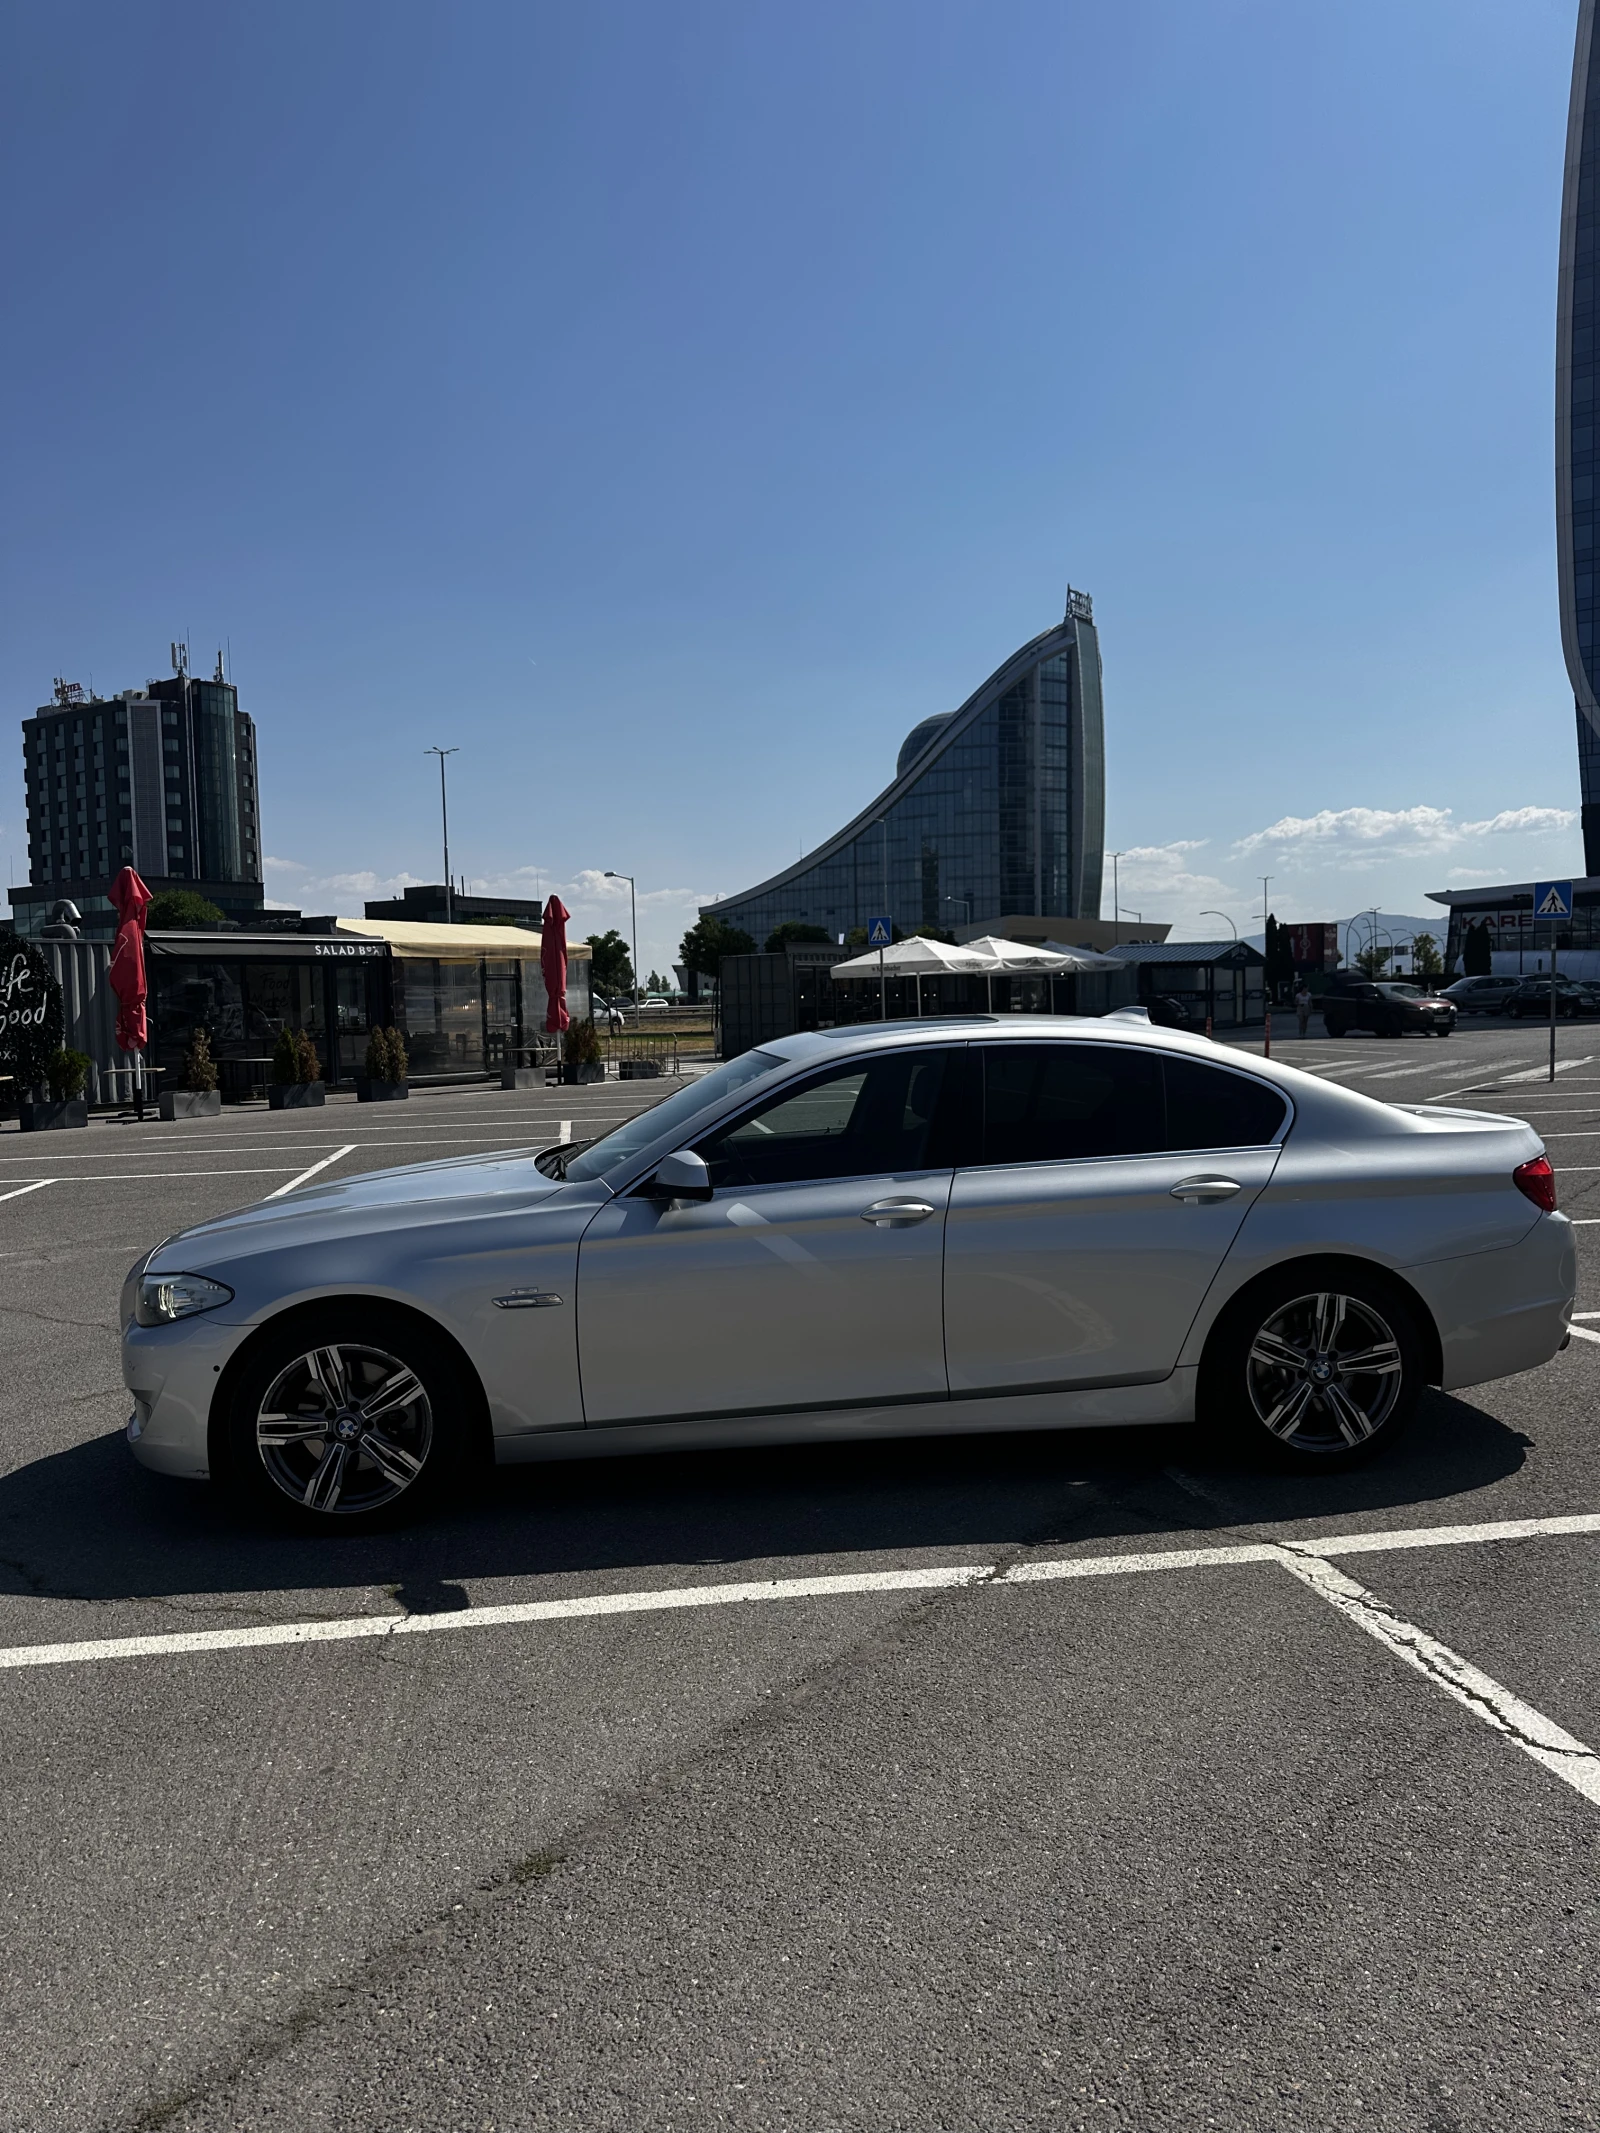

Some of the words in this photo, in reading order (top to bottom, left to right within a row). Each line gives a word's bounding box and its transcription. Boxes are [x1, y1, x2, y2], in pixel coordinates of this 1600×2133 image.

[1462, 914, 1533, 929] KARE
[314, 944, 355, 956] SALAD
[0, 953, 35, 1001] ife
[259, 968, 291, 990] Food
